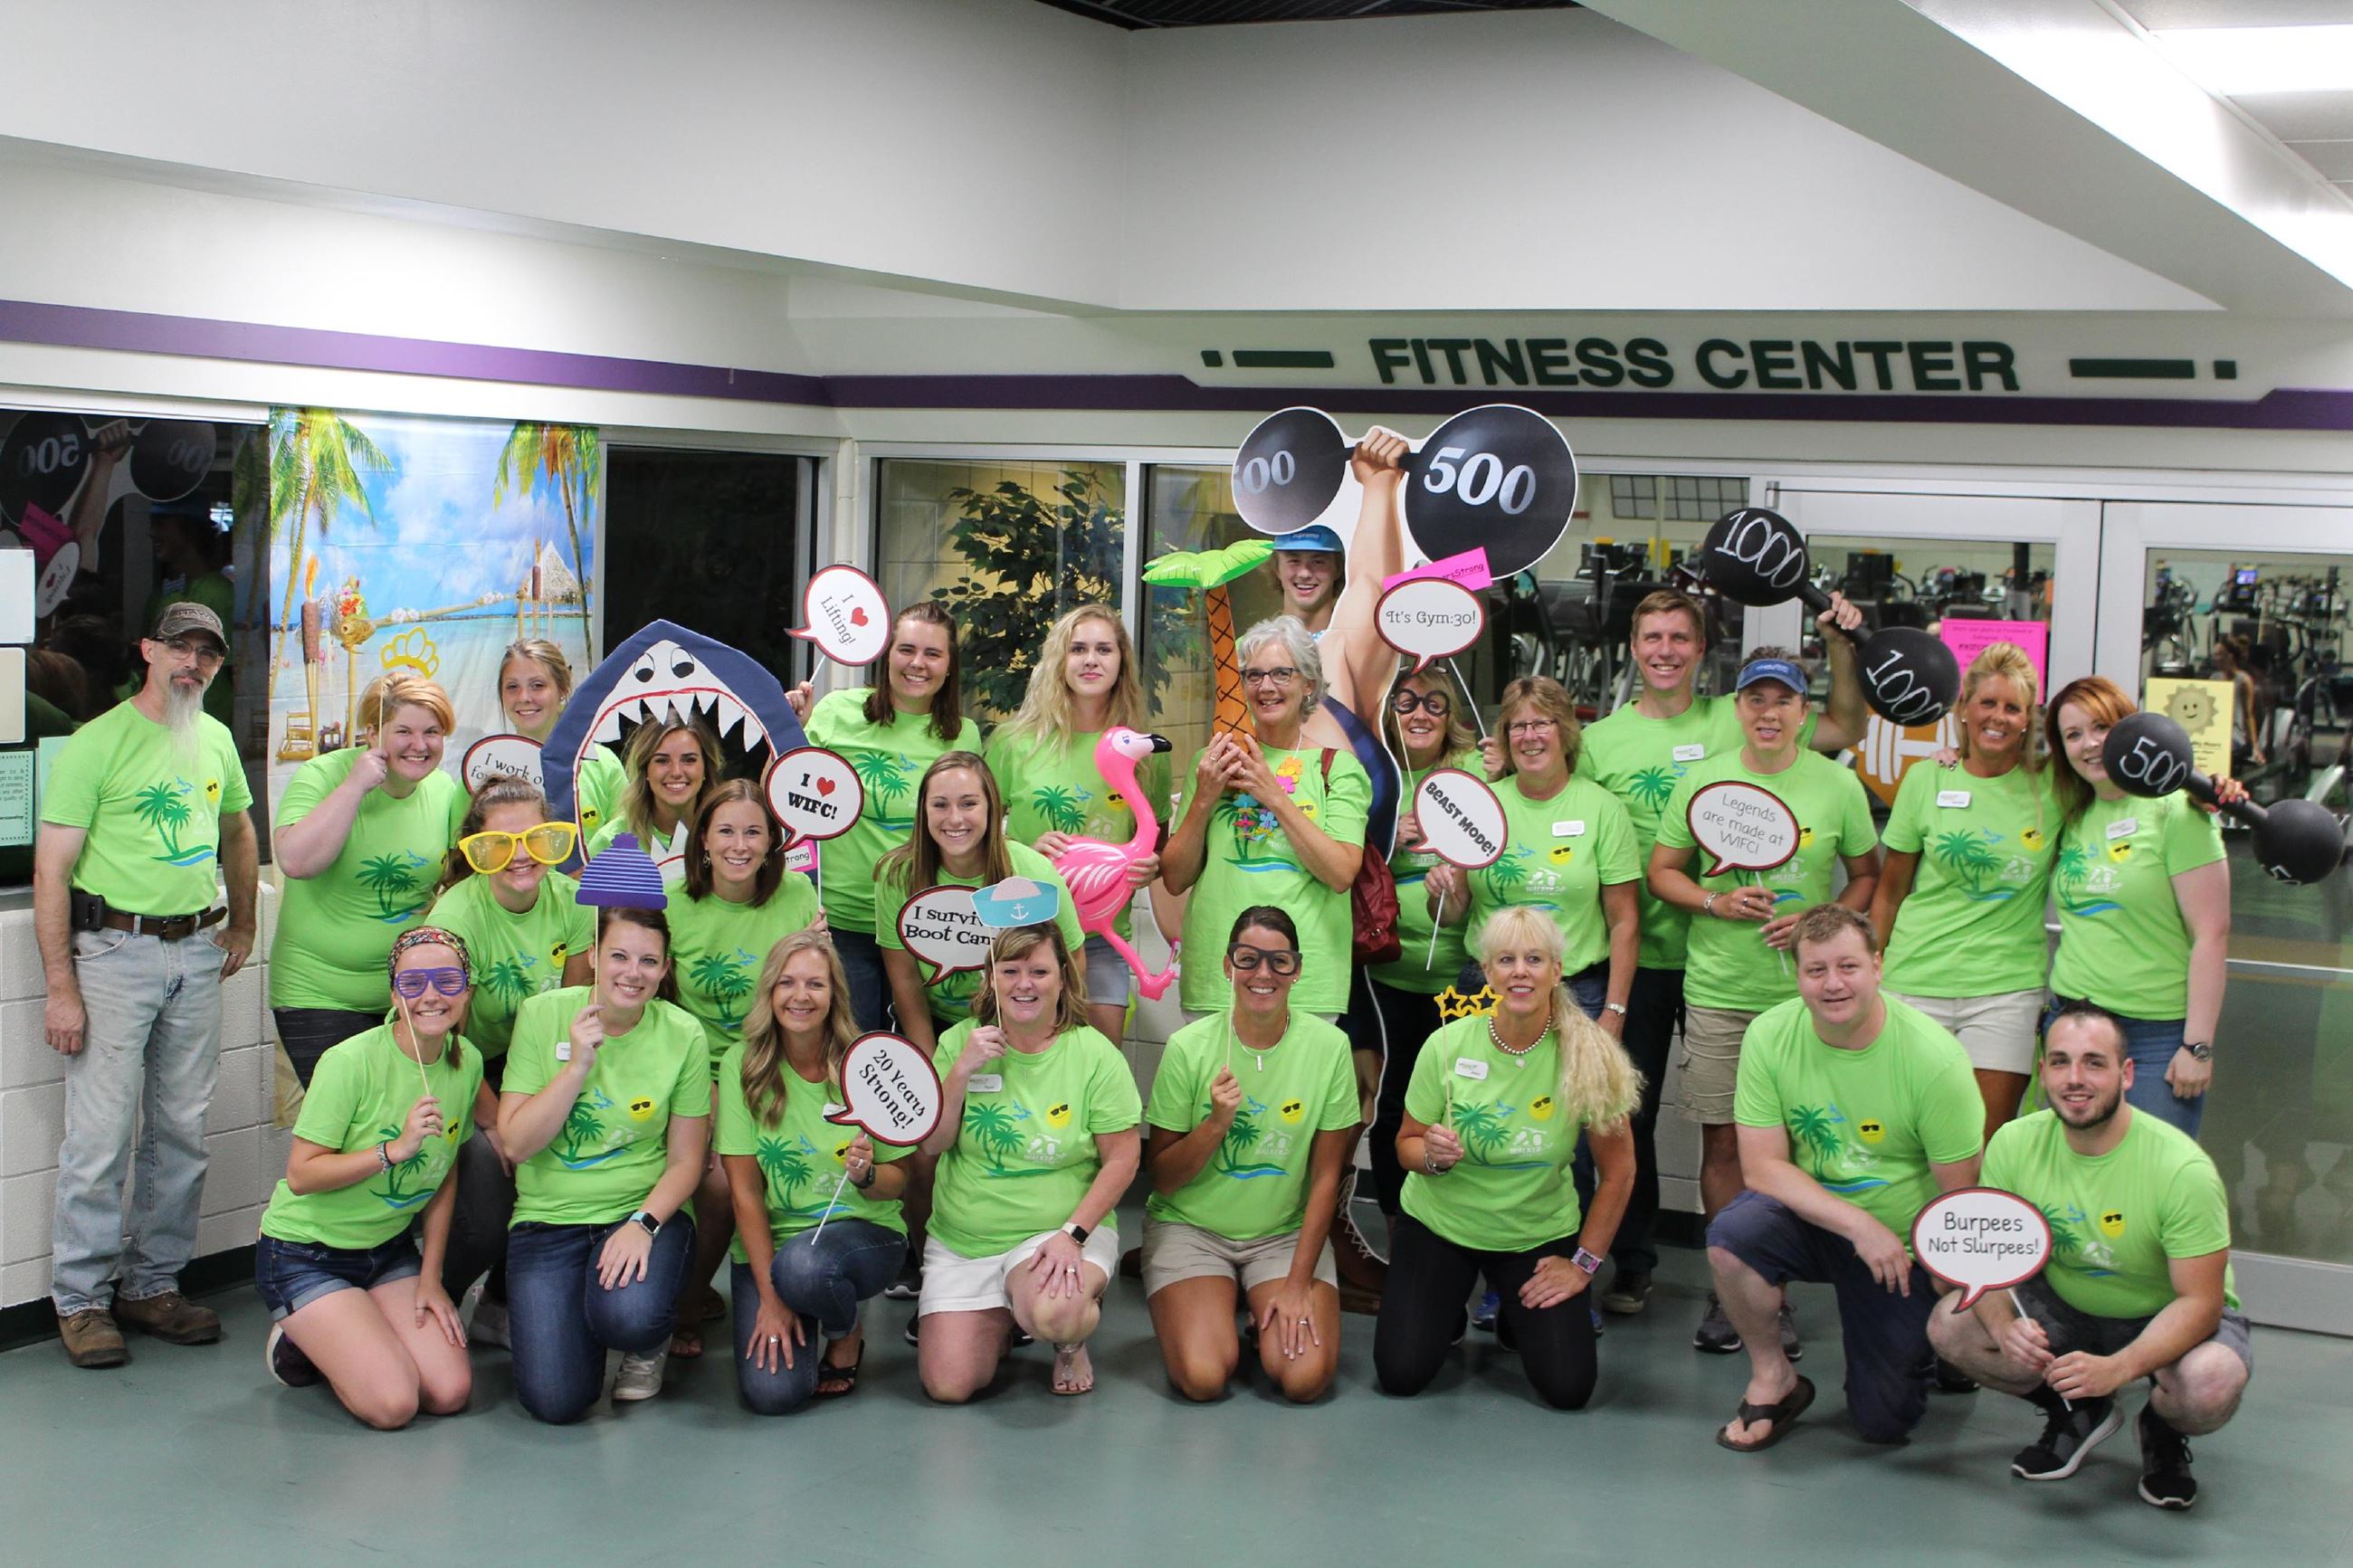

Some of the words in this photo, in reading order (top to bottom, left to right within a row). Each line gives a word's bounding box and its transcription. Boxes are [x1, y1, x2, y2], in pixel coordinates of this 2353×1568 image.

[1369, 338, 1674, 388] FITNESS
[1695, 339, 2020, 391] CENTER
[1424, 447, 1537, 515] 500
[1716, 510, 1805, 588] 1000
[842, 594, 854, 603] I
[820, 596, 856, 646] Lifting!
[1386, 610, 1411, 624] It's
[1416, 610, 1476, 627] Gym:30!
[471, 765, 489, 780] fo
[484, 753, 492, 766] I
[495, 760, 529, 780] work
[2119, 736, 2186, 794] 500
[801, 773, 810, 787] I
[788, 792, 837, 820] WIFC!
[1722, 793, 1776, 822] Legends
[1702, 811, 1724, 825] are
[1729, 819, 1766, 841] made
[1768, 834, 1784, 846] at
[913, 906, 922, 920] I
[905, 924, 953, 942] Boot
[860, 1064, 914, 1129] Strong!
[873, 1050, 893, 1071] 20
[891, 1069, 925, 1117] Years
[1944, 1212, 2024, 1239] Burpees
[1929, 1237, 1958, 1252] Not
[1963, 1238, 2039, 1261] Slurpees!
